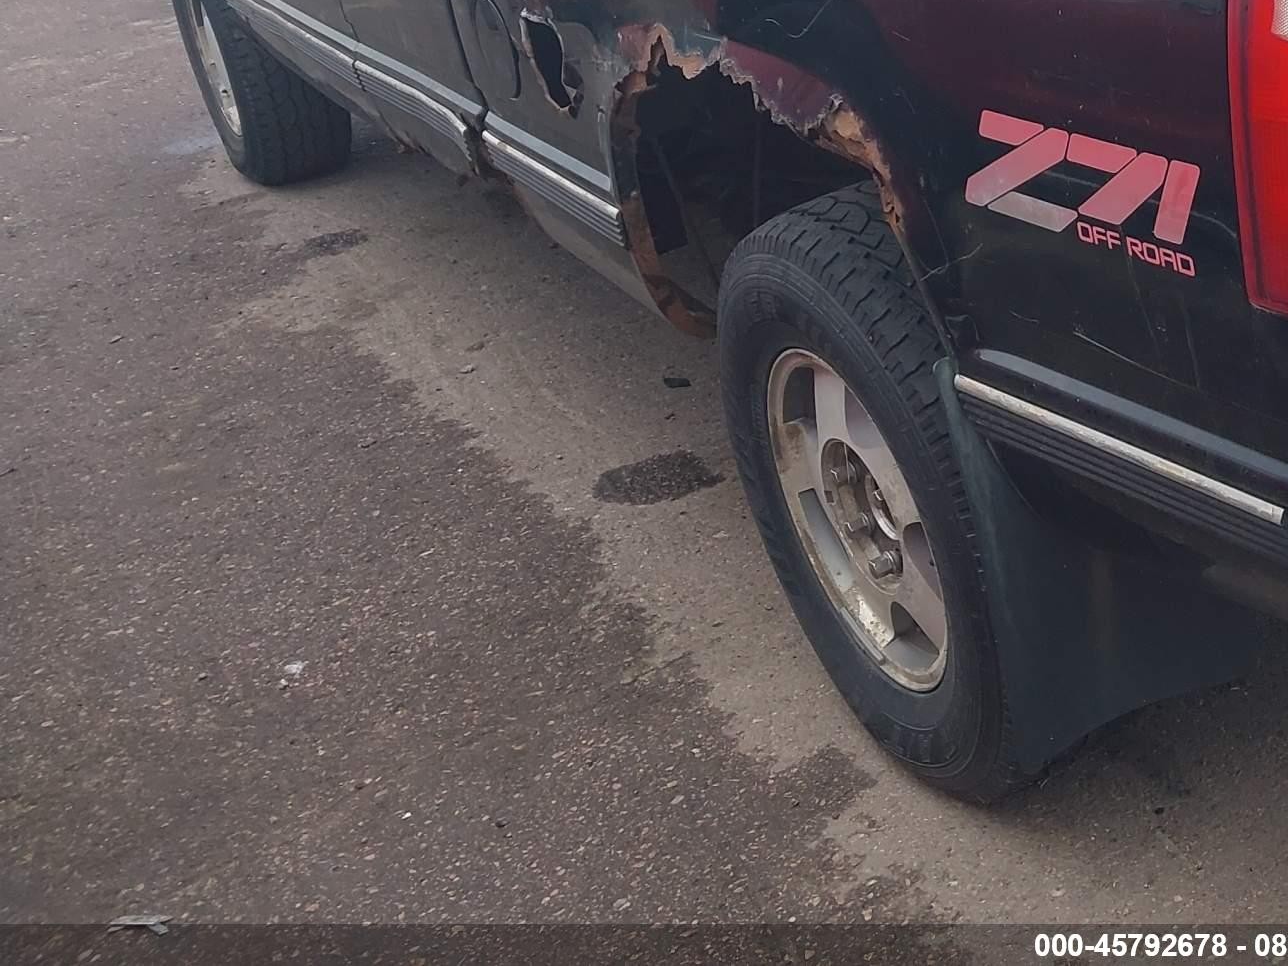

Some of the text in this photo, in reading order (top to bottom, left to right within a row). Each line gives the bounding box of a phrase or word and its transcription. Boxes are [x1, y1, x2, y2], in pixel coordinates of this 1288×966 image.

[965, 109, 1200, 245] Z71
[1076, 221, 1196, 277] OFF ROAD
